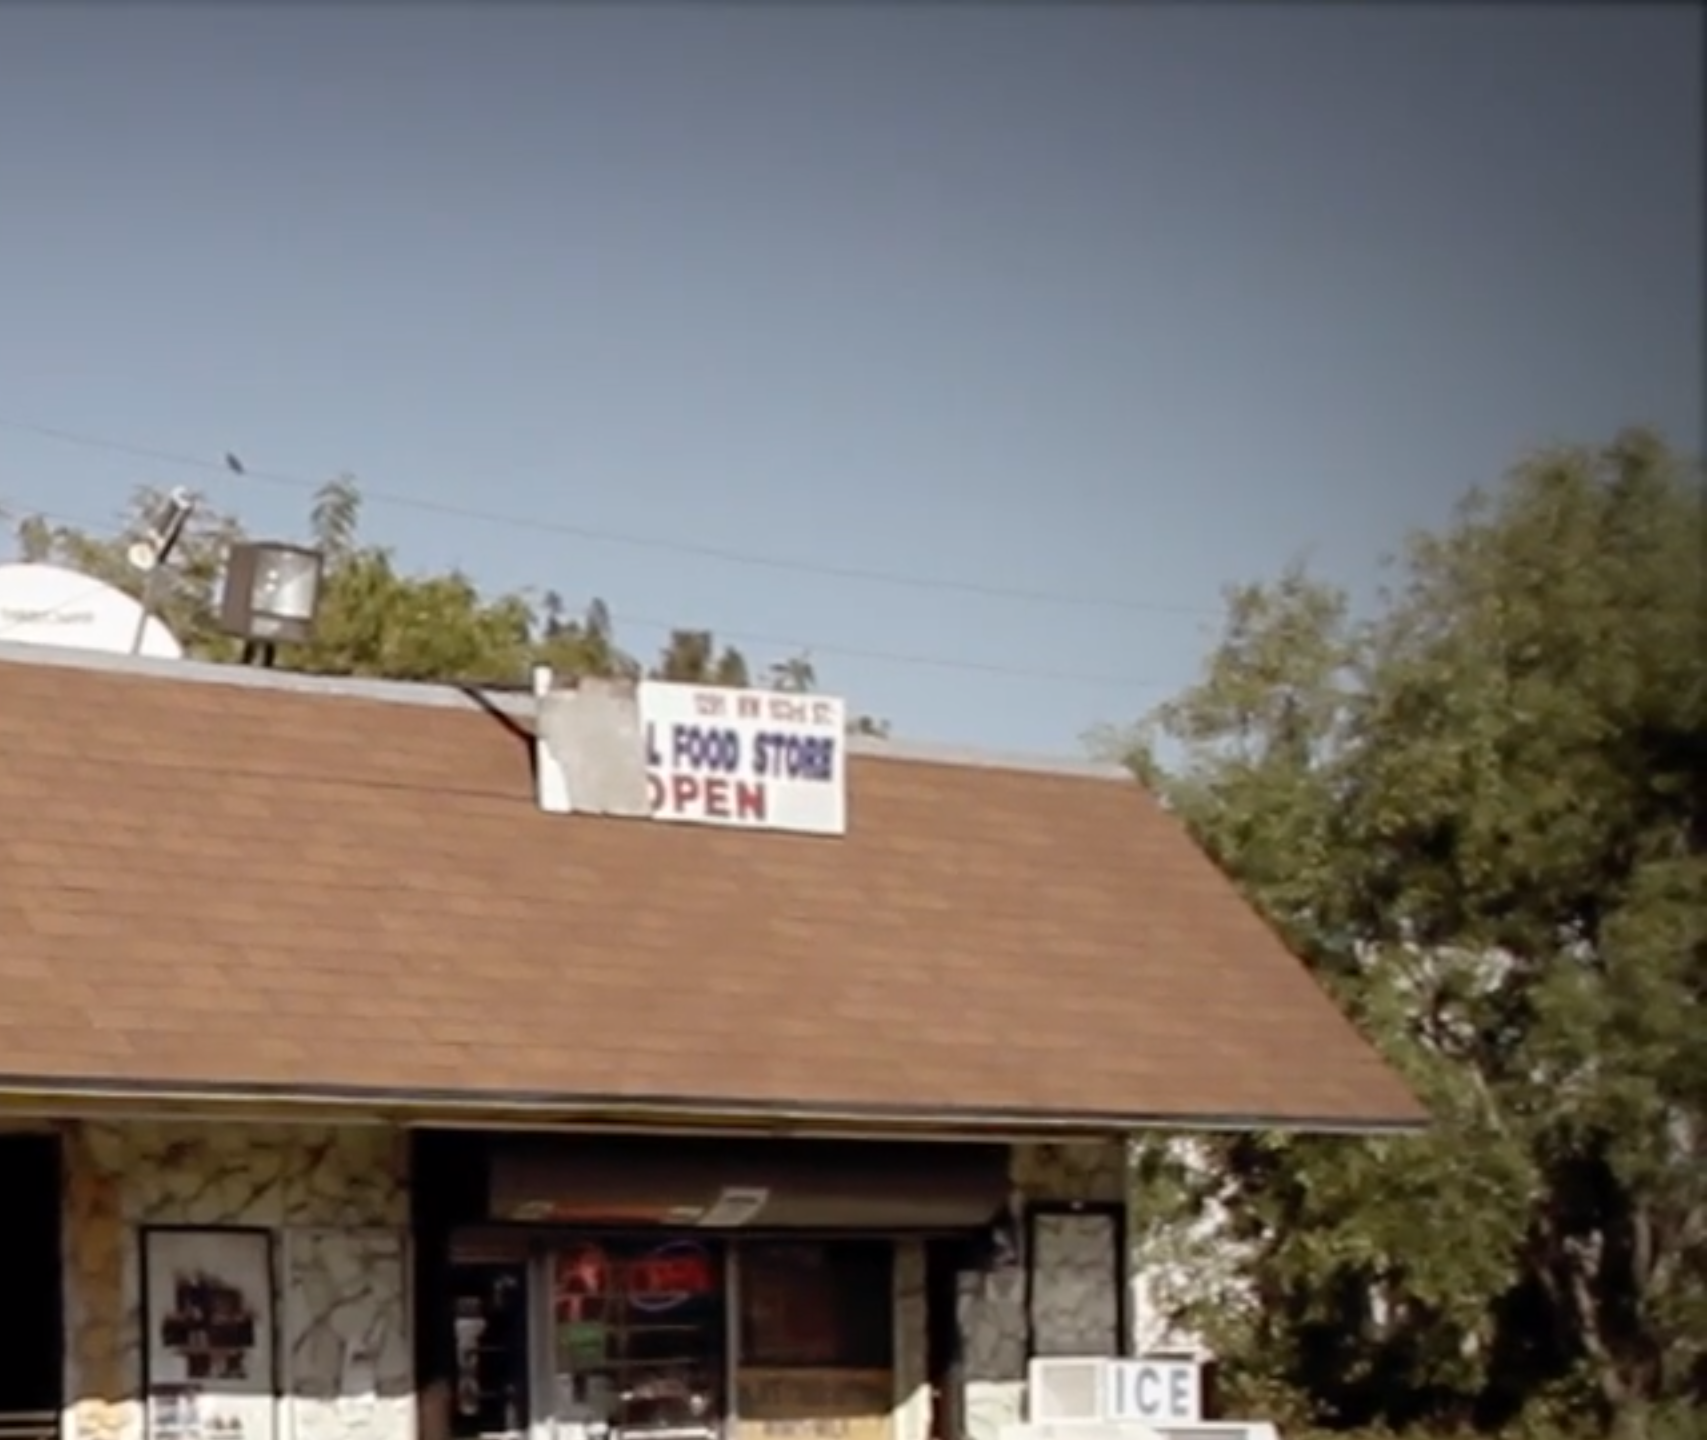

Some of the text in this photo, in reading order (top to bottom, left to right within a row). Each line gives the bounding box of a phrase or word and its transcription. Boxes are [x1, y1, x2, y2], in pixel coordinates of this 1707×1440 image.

[673, 724, 740, 773] FOOD
[753, 730, 834, 782] STORE
[1114, 1366, 1189, 1416] ICE
